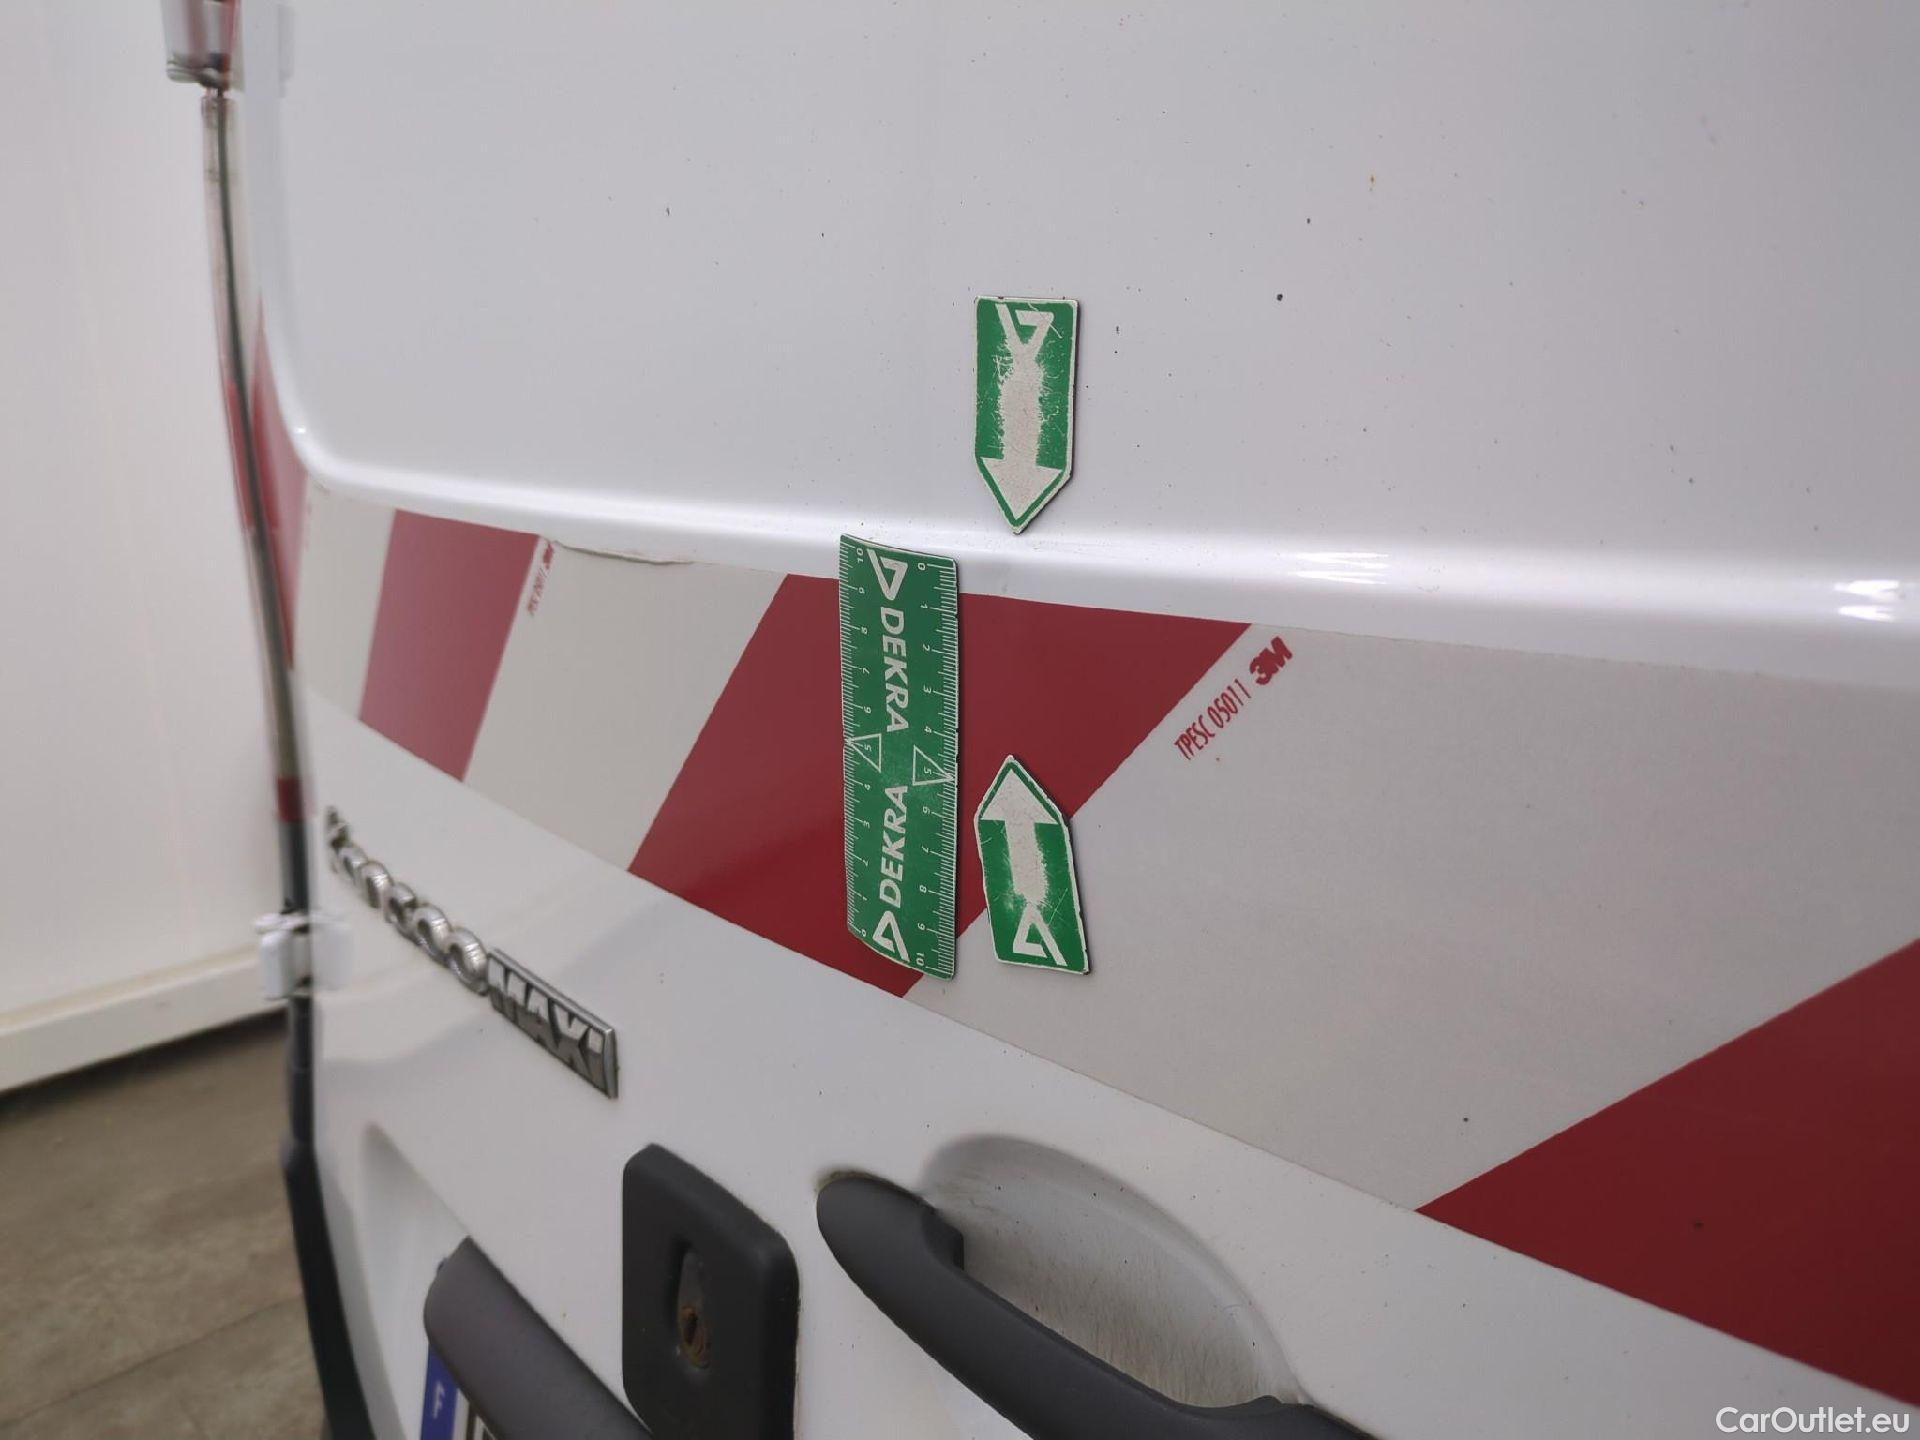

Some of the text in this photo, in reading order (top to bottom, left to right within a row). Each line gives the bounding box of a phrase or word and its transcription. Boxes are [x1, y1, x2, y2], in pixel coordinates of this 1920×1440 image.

[917, 562, 926, 571] 0
[922, 644, 931, 652] 2
[880, 606, 909, 732] DEKRA
[923, 686, 932, 694] 3
[1174, 636, 1293, 761] TPESC 05011 3M
[924, 726, 933, 734] 4
[923, 767, 932, 775] 5
[922, 806, 931, 815] 6
[879, 785, 909, 909] DEKRA
[921, 846, 930, 854] 7
[919, 884, 928, 894] 8
[917, 922, 926, 931] 9
[916, 952, 925, 967] 10
[487, 950, 613, 1097] MAXI
